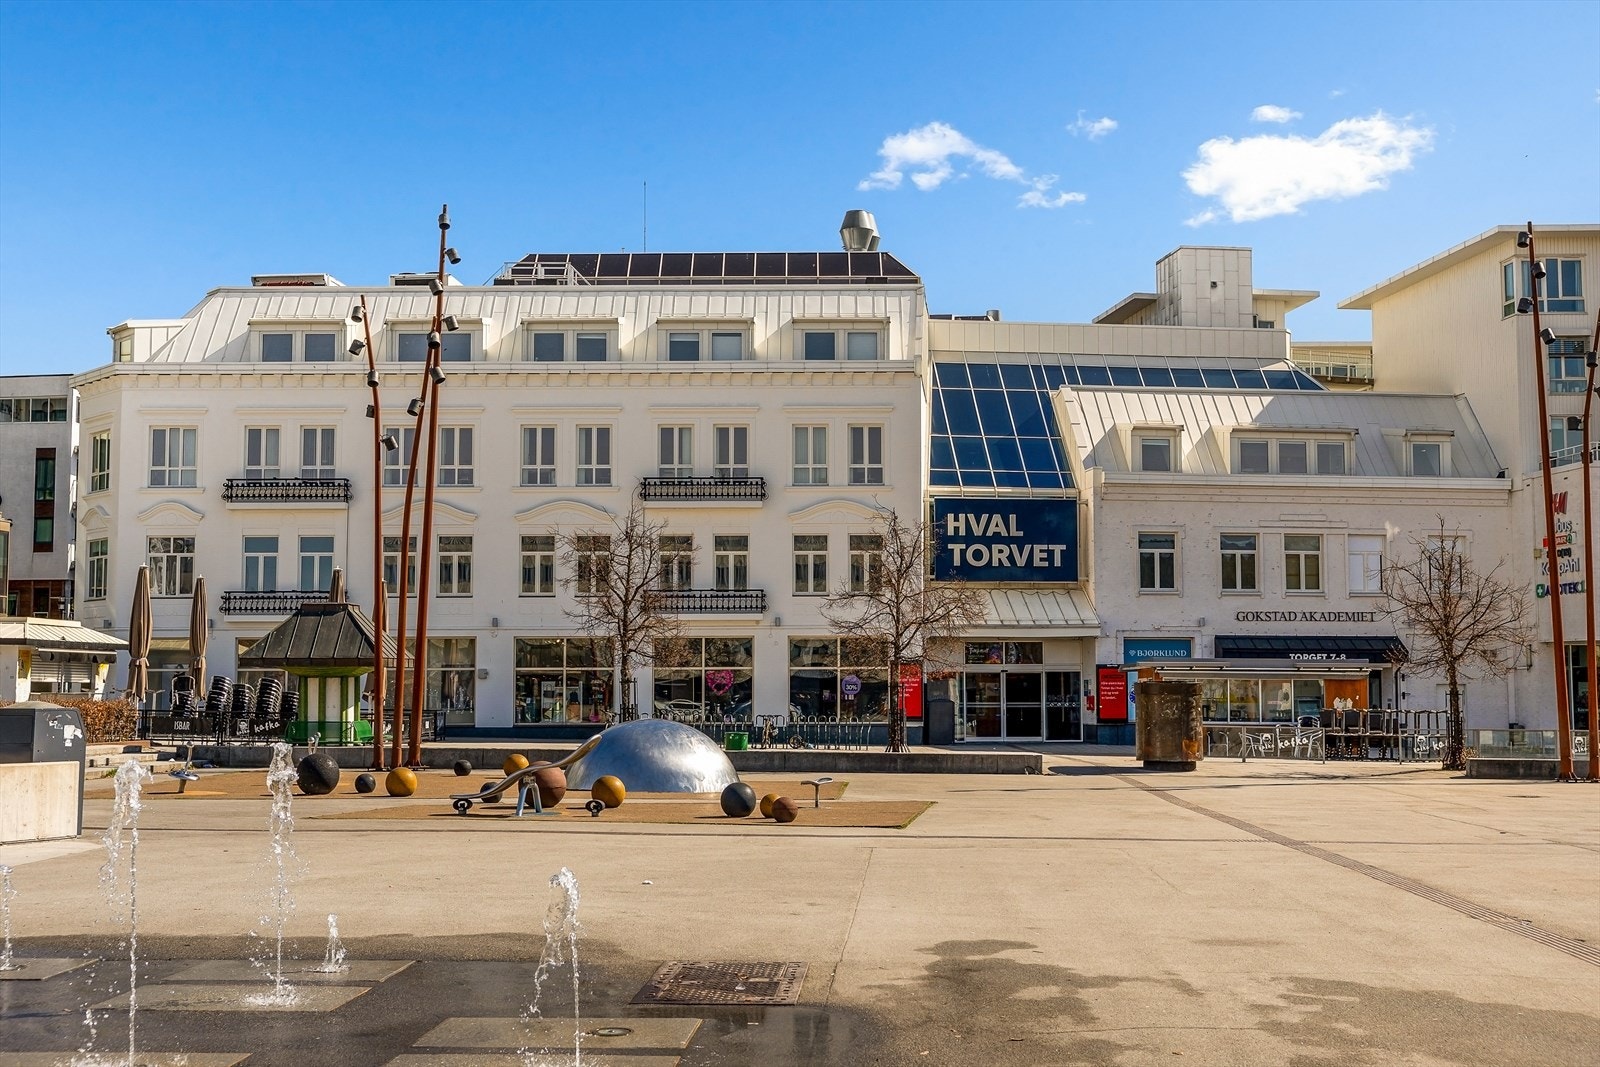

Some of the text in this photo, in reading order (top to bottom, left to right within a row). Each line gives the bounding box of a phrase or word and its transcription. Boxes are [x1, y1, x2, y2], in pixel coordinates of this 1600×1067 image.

[947, 513, 1024, 537] HVAL
[947, 543, 1067, 567] TORVET
[1544, 582, 1579, 596] AOTEK
[1236, 611, 1377, 622] GOKSTAD AKADEMIET
[1137, 649, 1187, 657] BJØRKLUND
[254, 721, 280, 733] kafka
[1278, 737, 1309, 749] kafka
